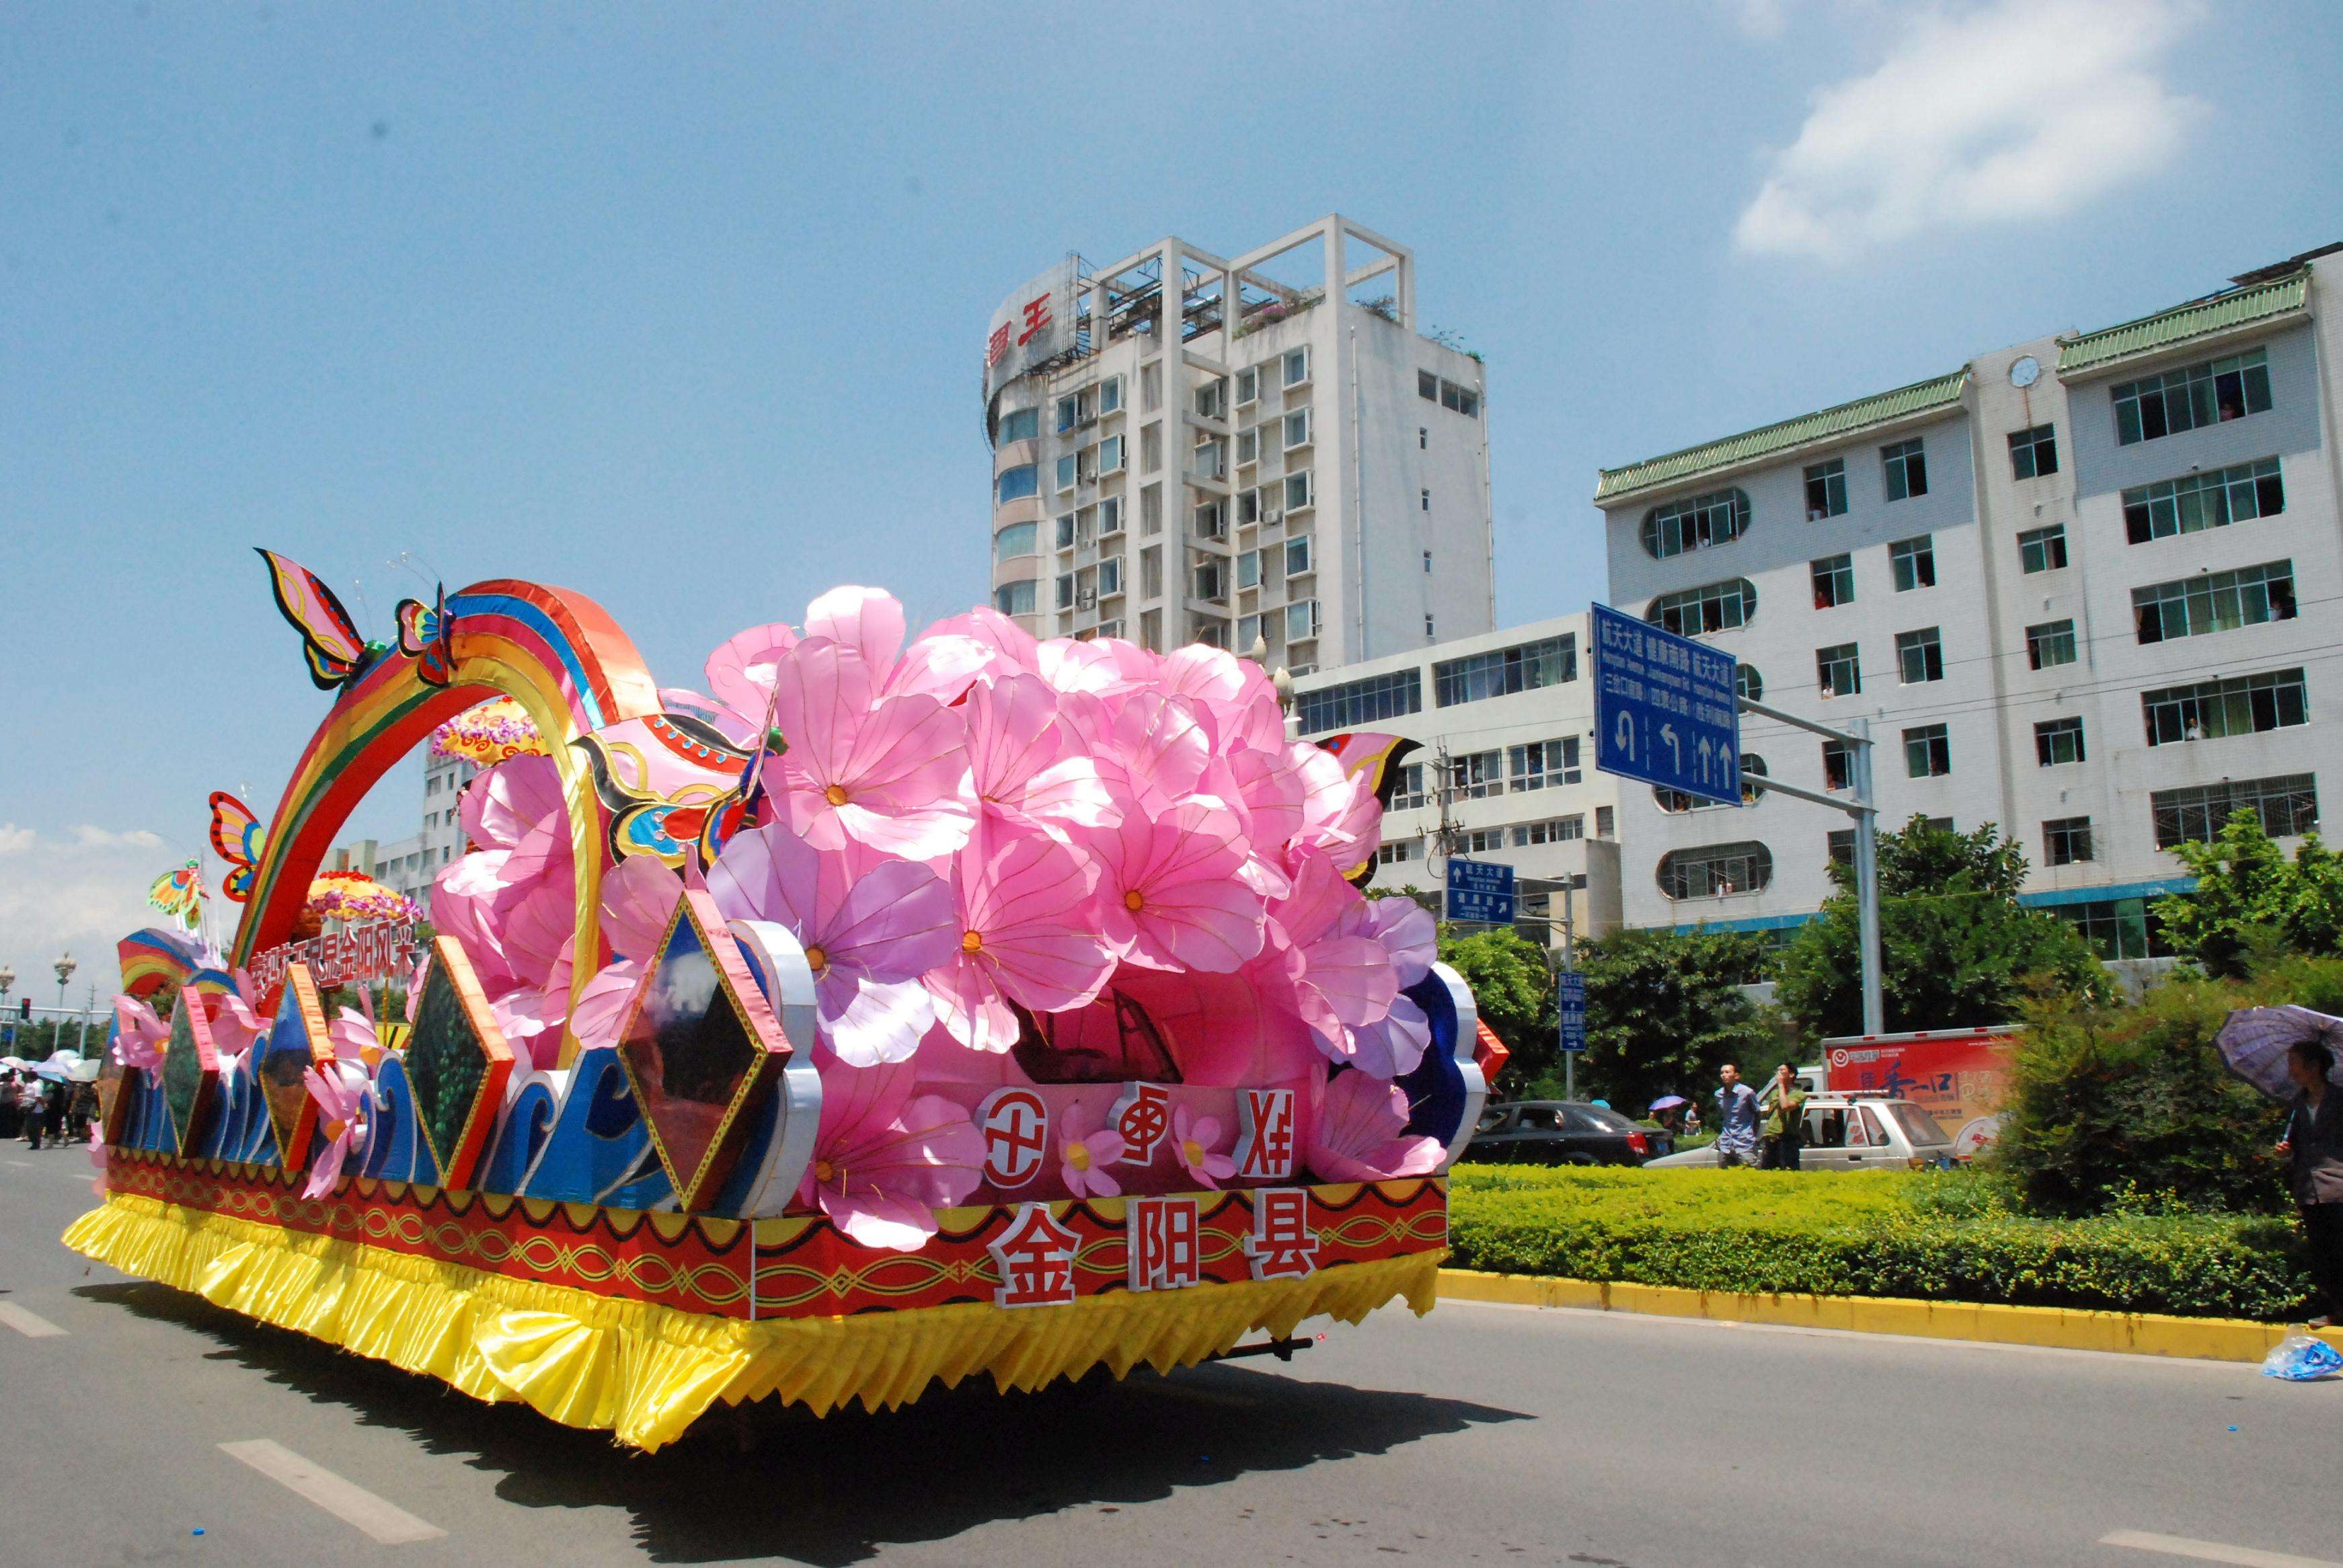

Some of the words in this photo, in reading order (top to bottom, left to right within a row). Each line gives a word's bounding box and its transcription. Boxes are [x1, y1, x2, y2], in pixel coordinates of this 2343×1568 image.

[1602, 618, 1643, 658] 航天大道
[1646, 635, 1690, 672] 健康南路
[1692, 650, 1730, 688] 航天大道
[999, 1193, 1316, 1304] 金阳县
